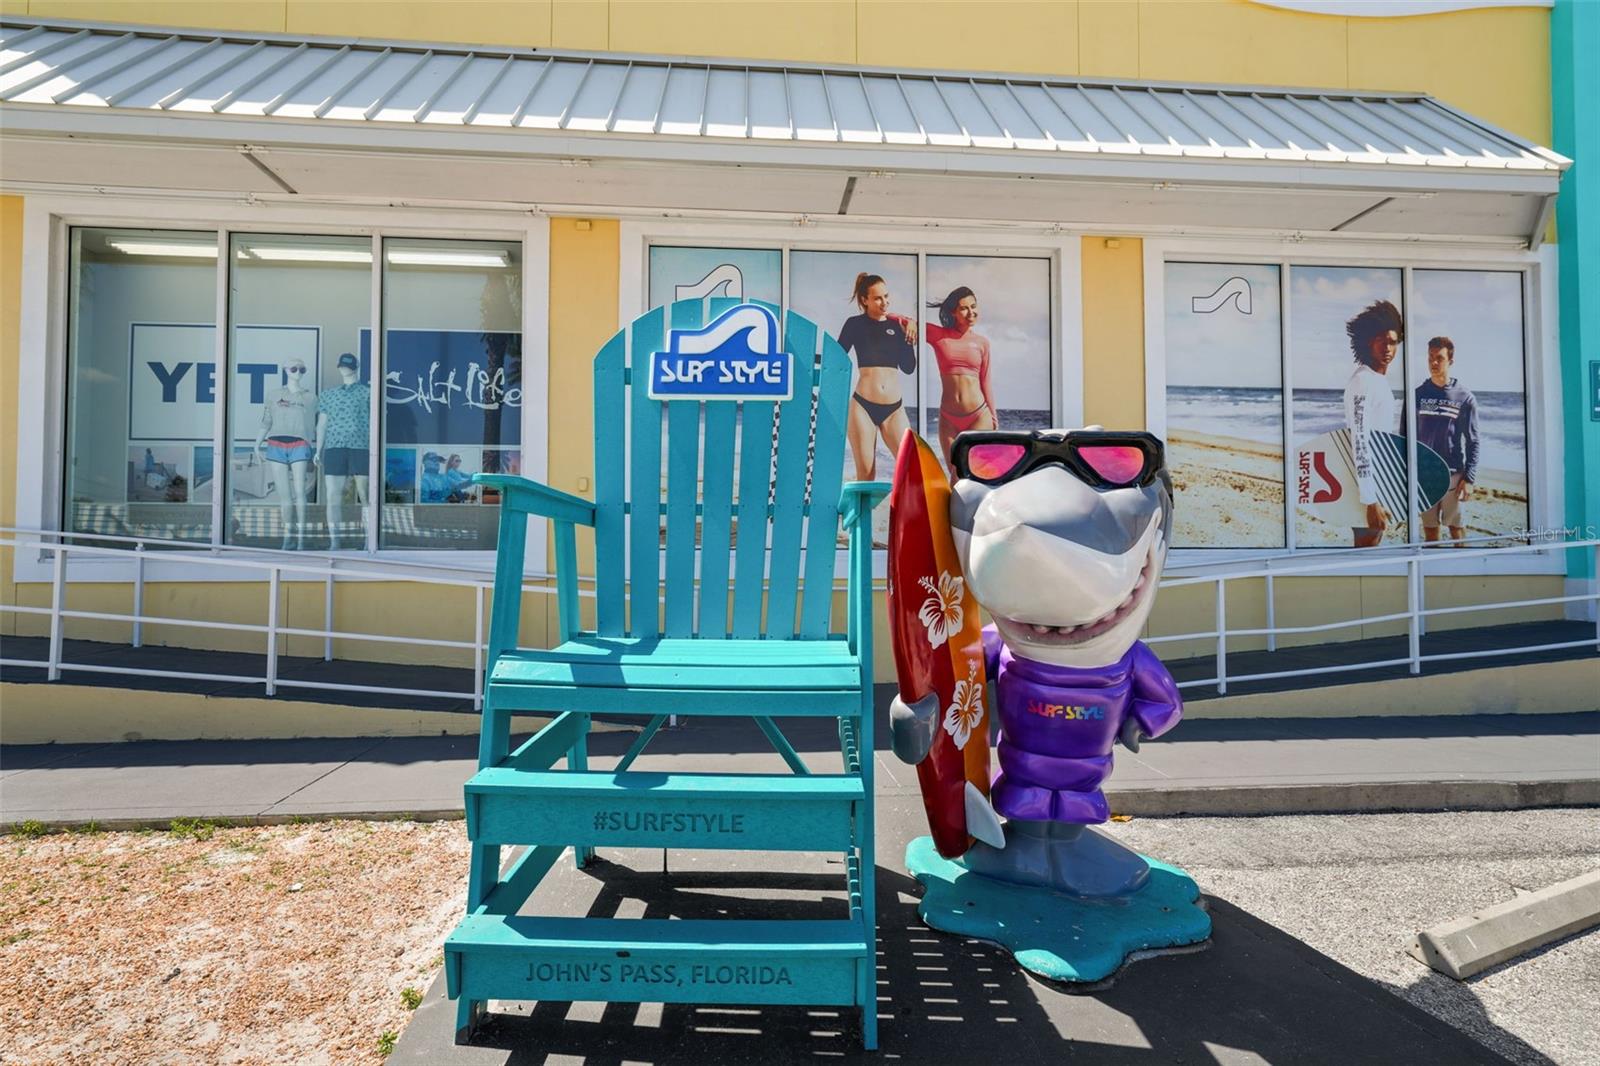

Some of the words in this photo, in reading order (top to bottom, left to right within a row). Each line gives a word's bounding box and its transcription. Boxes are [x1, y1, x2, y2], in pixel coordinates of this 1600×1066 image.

[147, 362, 288, 404] YET
[660, 360, 715, 383] SURF
[719, 361, 782, 383] STYLE
[1065, 704, 1105, 720] STYLE
[592, 811, 745, 834] #SURFSTYLE
[526, 962, 612, 982] JOHN'S
[620, 964, 683, 987] PASS,
[691, 965, 792, 986] FLORIDA
